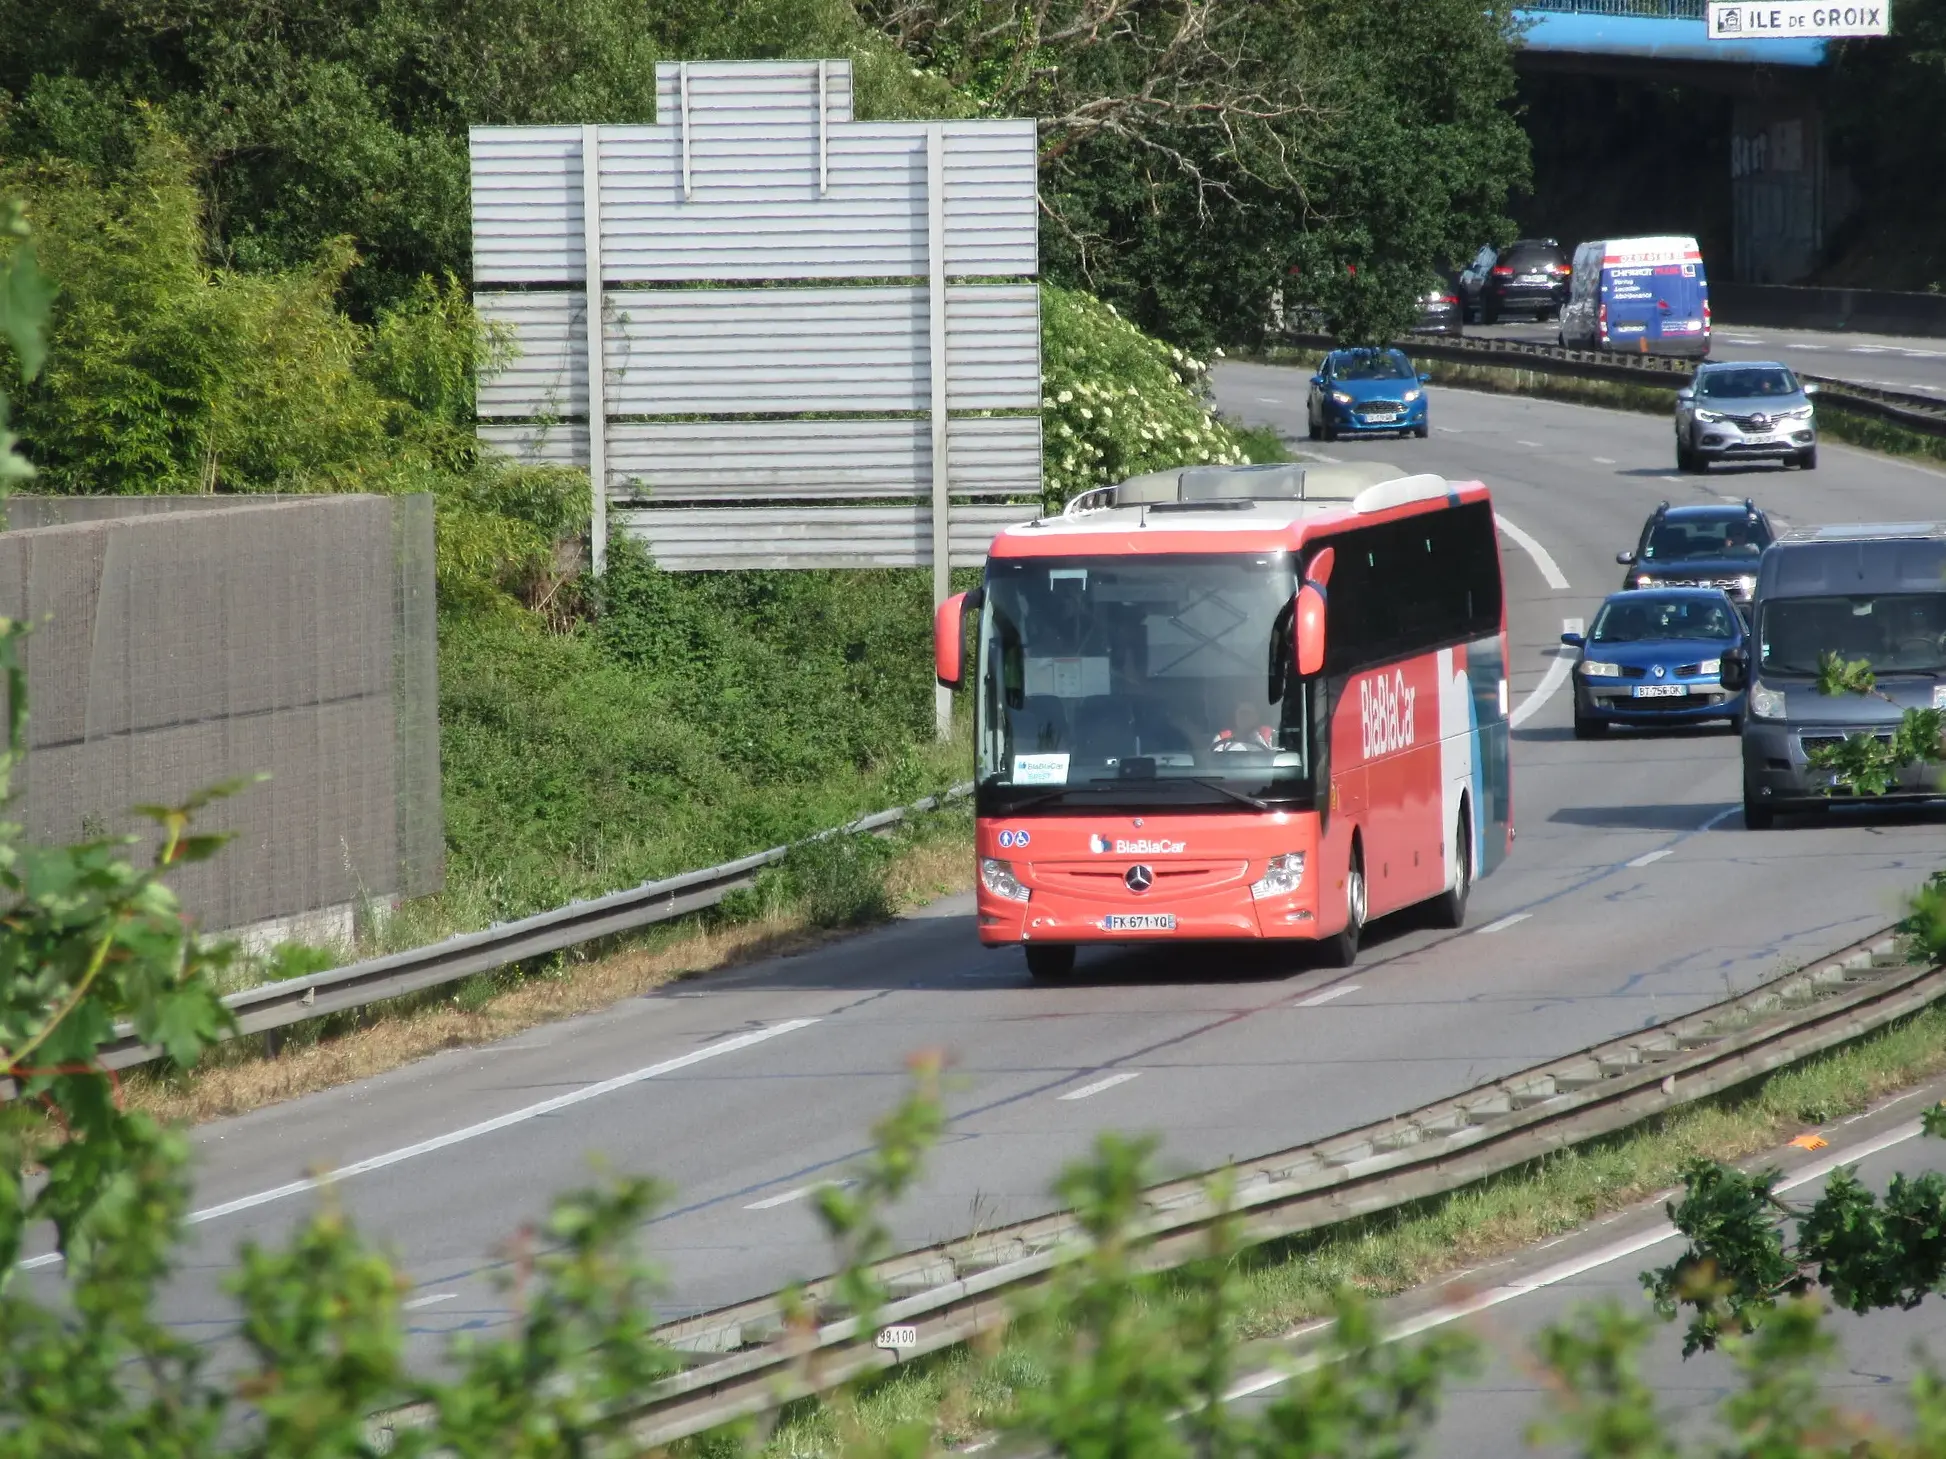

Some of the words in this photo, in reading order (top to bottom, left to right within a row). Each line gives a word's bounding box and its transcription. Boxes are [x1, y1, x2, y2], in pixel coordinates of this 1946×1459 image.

[1749, 10, 1782, 29] ILE
[1788, 15, 1806, 28] DE
[1812, 7, 1880, 27] GROIX
[1360, 668, 1416, 760] BlaBlaCar
[1116, 839, 1187, 854] BlaBlaCar
[1113, 916, 1167, 928] FK-671-YQ
